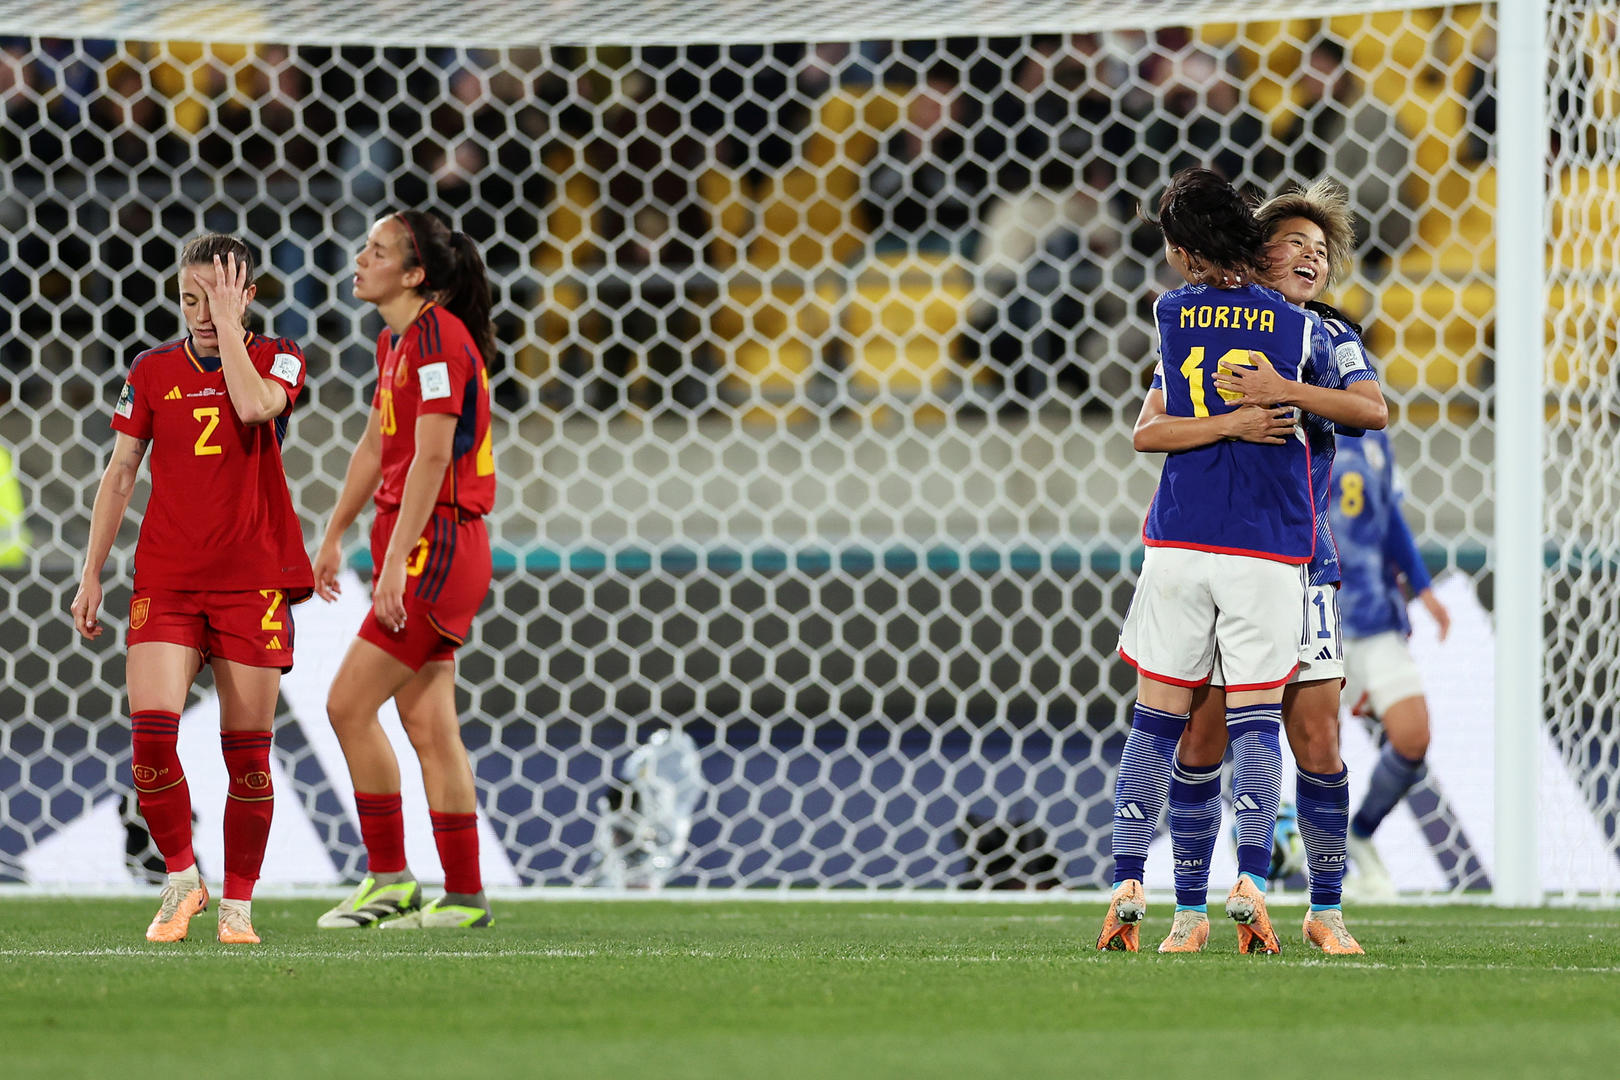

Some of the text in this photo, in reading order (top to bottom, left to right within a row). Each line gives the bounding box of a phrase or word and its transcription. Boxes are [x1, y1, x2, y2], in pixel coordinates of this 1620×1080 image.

[1180, 305, 1275, 333] MORIYA
[193, 406, 222, 456] 2
[1340, 471, 1364, 518] 8
[259, 589, 283, 631] 2
[1312, 590, 1331, 639] 1
